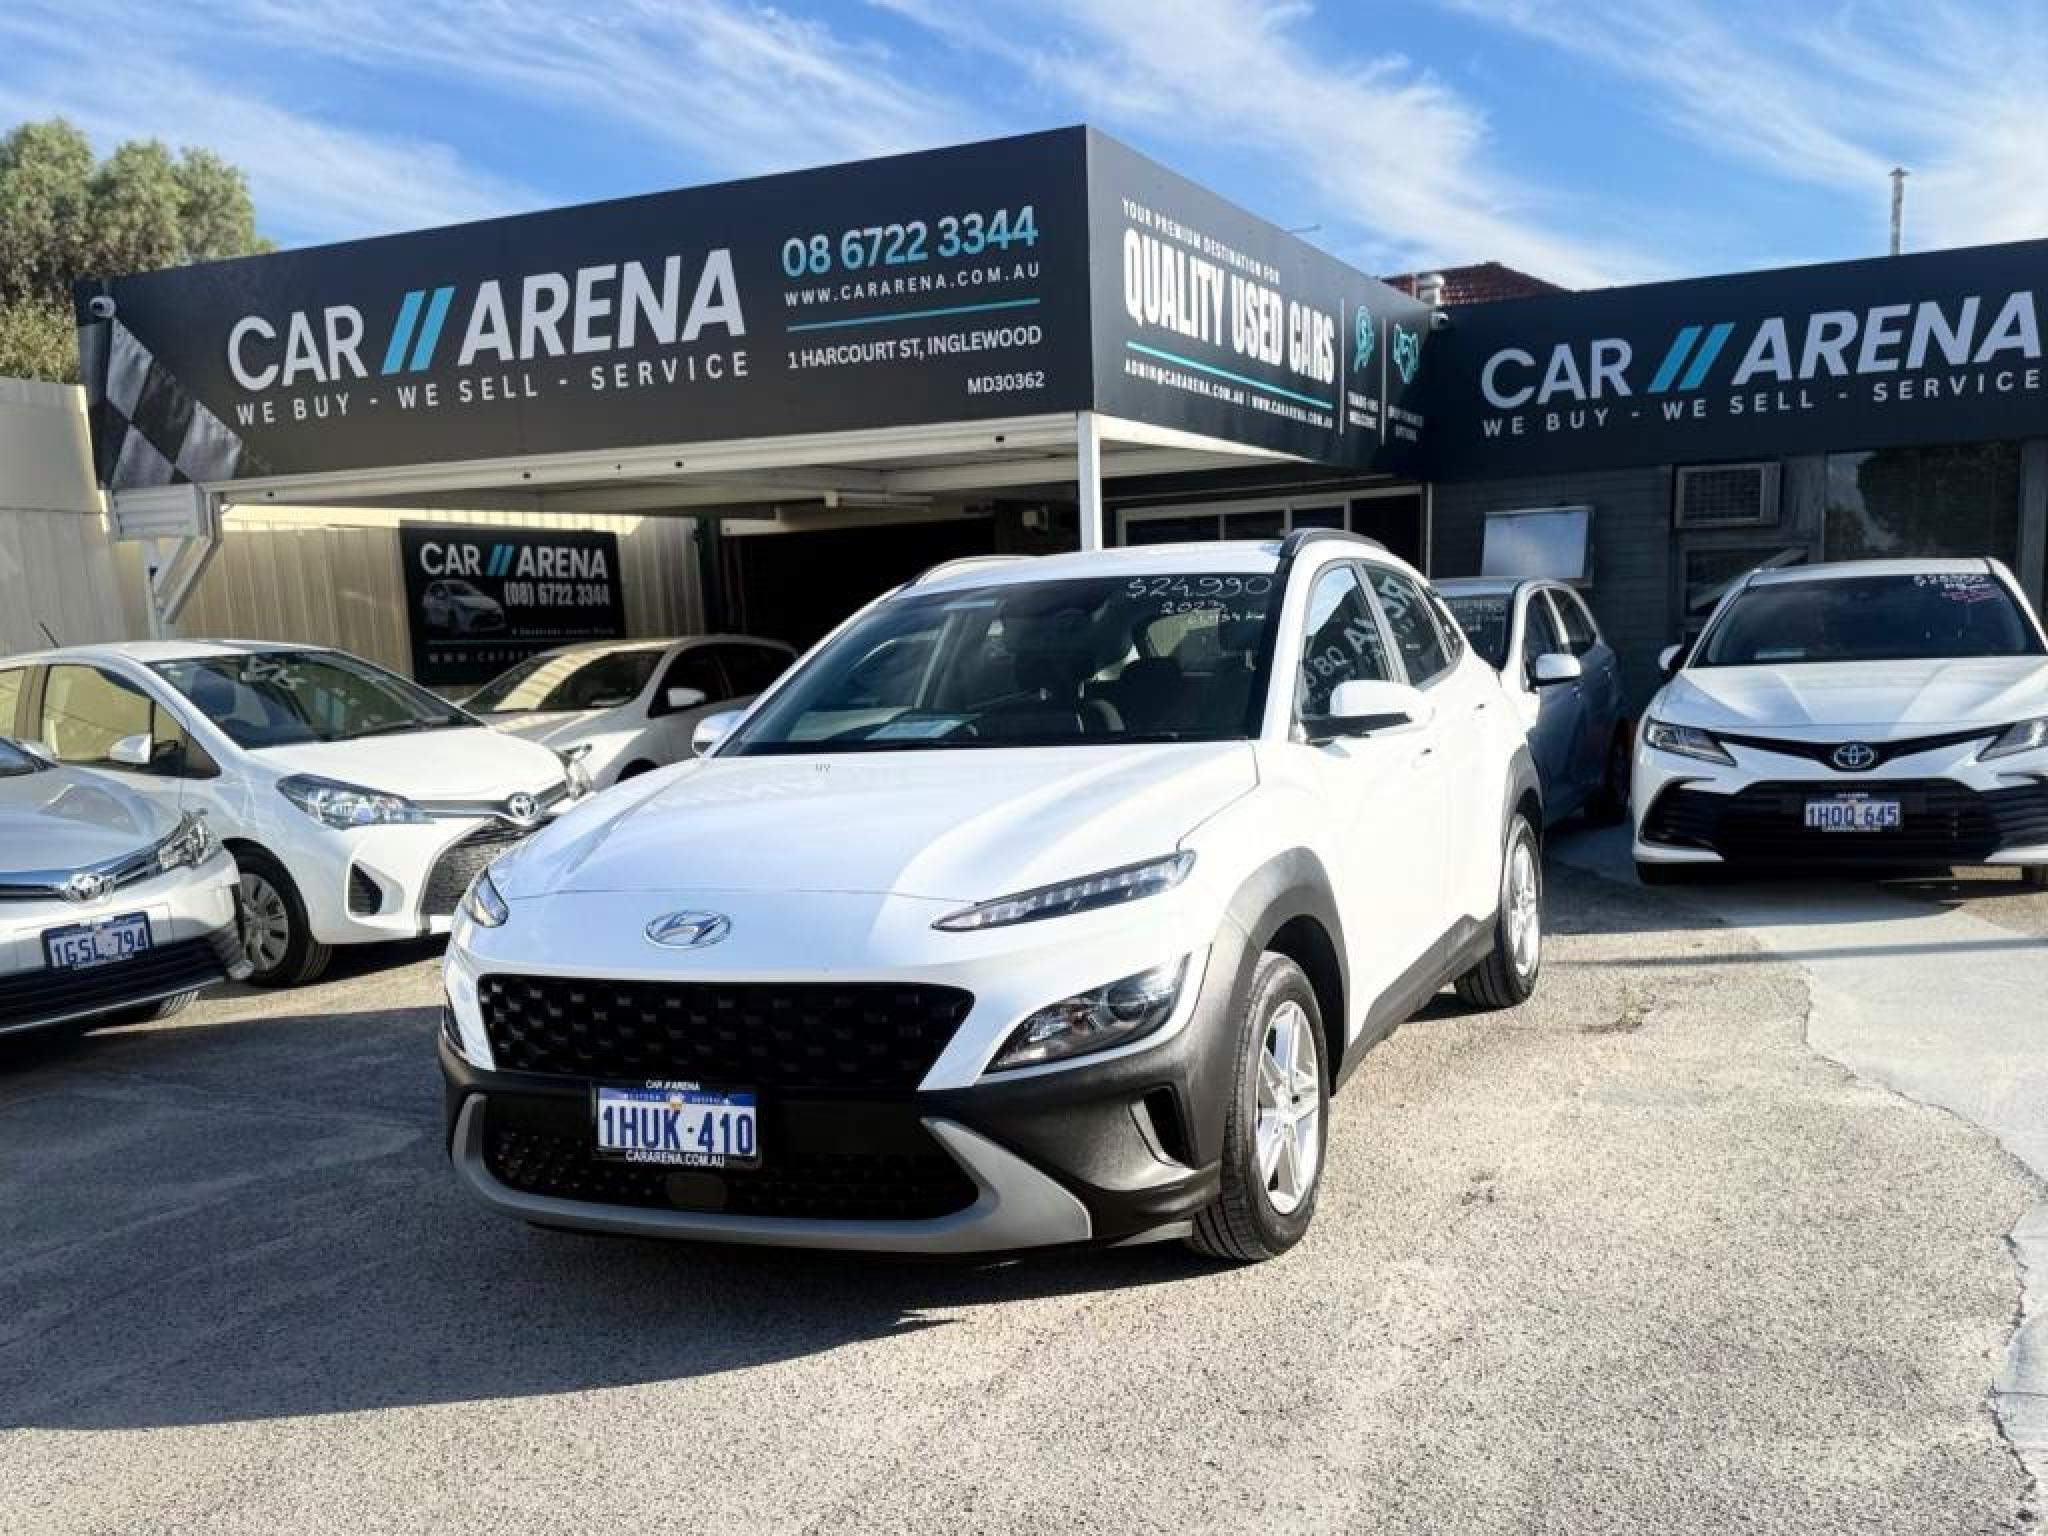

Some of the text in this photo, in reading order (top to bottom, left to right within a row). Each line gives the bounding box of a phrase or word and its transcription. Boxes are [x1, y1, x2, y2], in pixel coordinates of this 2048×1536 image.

[782, 205, 1039, 277] 08 6722 3344
[784, 261, 1041, 307] WWW.CARARENA.COM.AU
[1123, 227, 1335, 384] QUALITY USED CARS
[227, 248, 747, 392] CAR ARENA
[787, 325, 1043, 369] 1 HARCOURT ST, INGLEWOOD
[1481, 290, 2043, 409] CAR ARENA
[236, 400, 276, 427] WE
[293, 391, 350, 422] BUY
[397, 382, 440, 410] WE
[458, 373, 539, 403] SELL
[590, 350, 750, 393] SERVICE
[967, 370, 1045, 394] MD30362
[1483, 416, 1525, 438] WE
[1546, 407, 1608, 433] BUY
[1663, 397, 1708, 422] WE
[1729, 390, 1815, 415] SELL
[1873, 368, 2042, 402] SERVICE
[419, 541, 609, 580] CAR ARENA
[538, 582, 574, 607] 6722
[576, 583, 610, 608] 3344
